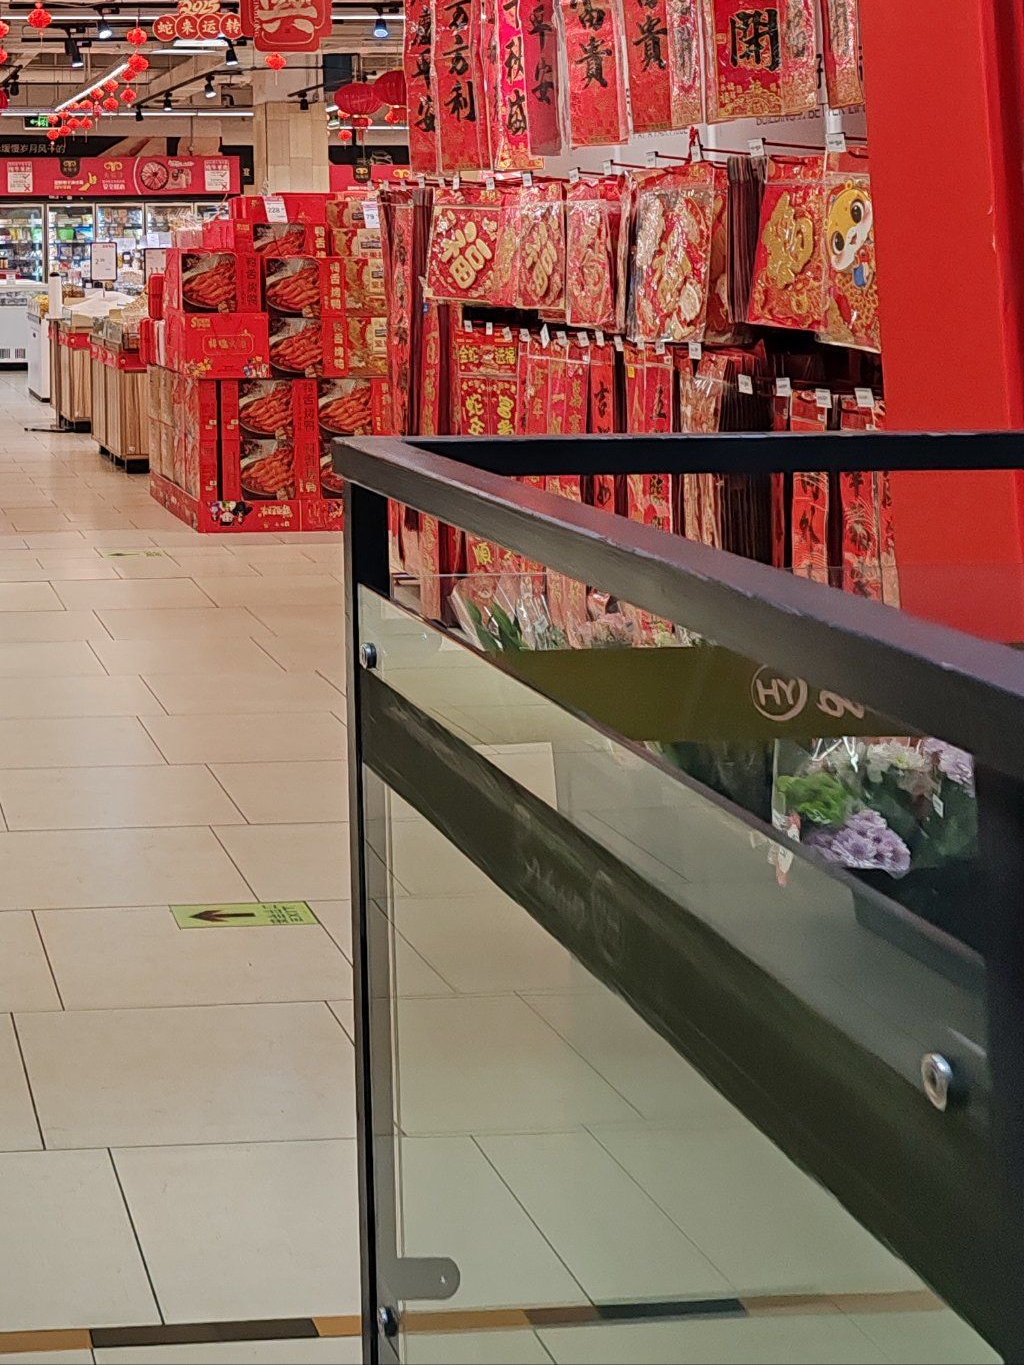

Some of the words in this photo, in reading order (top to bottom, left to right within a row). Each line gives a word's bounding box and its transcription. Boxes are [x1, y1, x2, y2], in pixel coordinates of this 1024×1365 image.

[157, 17, 242, 36] 蛇来运转
[440, 220, 494, 290] 福
